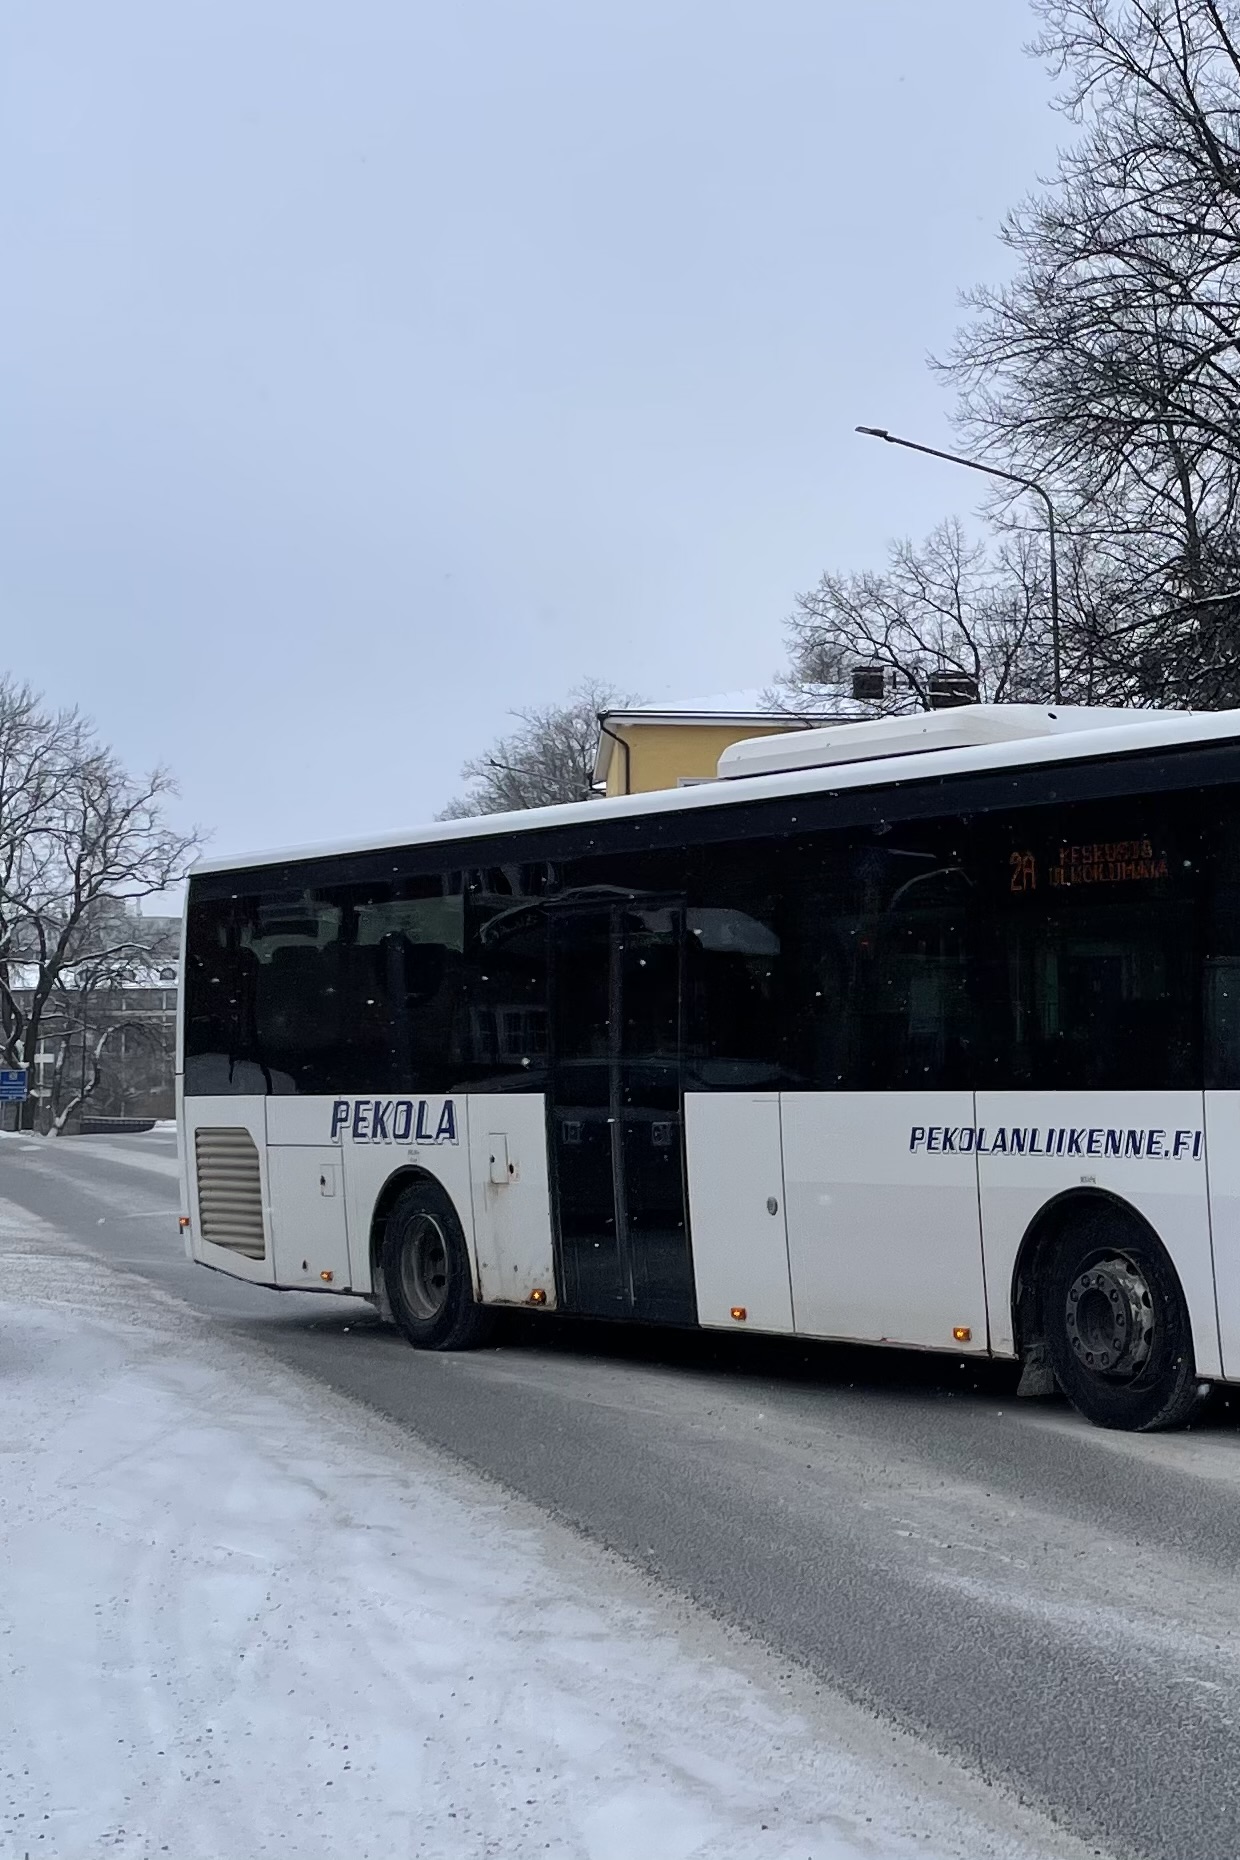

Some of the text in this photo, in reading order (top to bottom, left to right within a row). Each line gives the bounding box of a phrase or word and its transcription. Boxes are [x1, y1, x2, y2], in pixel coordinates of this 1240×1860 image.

[1009, 851, 1037, 891] 2A
[330, 1099, 460, 1146] PEKOLA
[909, 1126, 1204, 1160] PEKOLANLIIKENNE.FI
